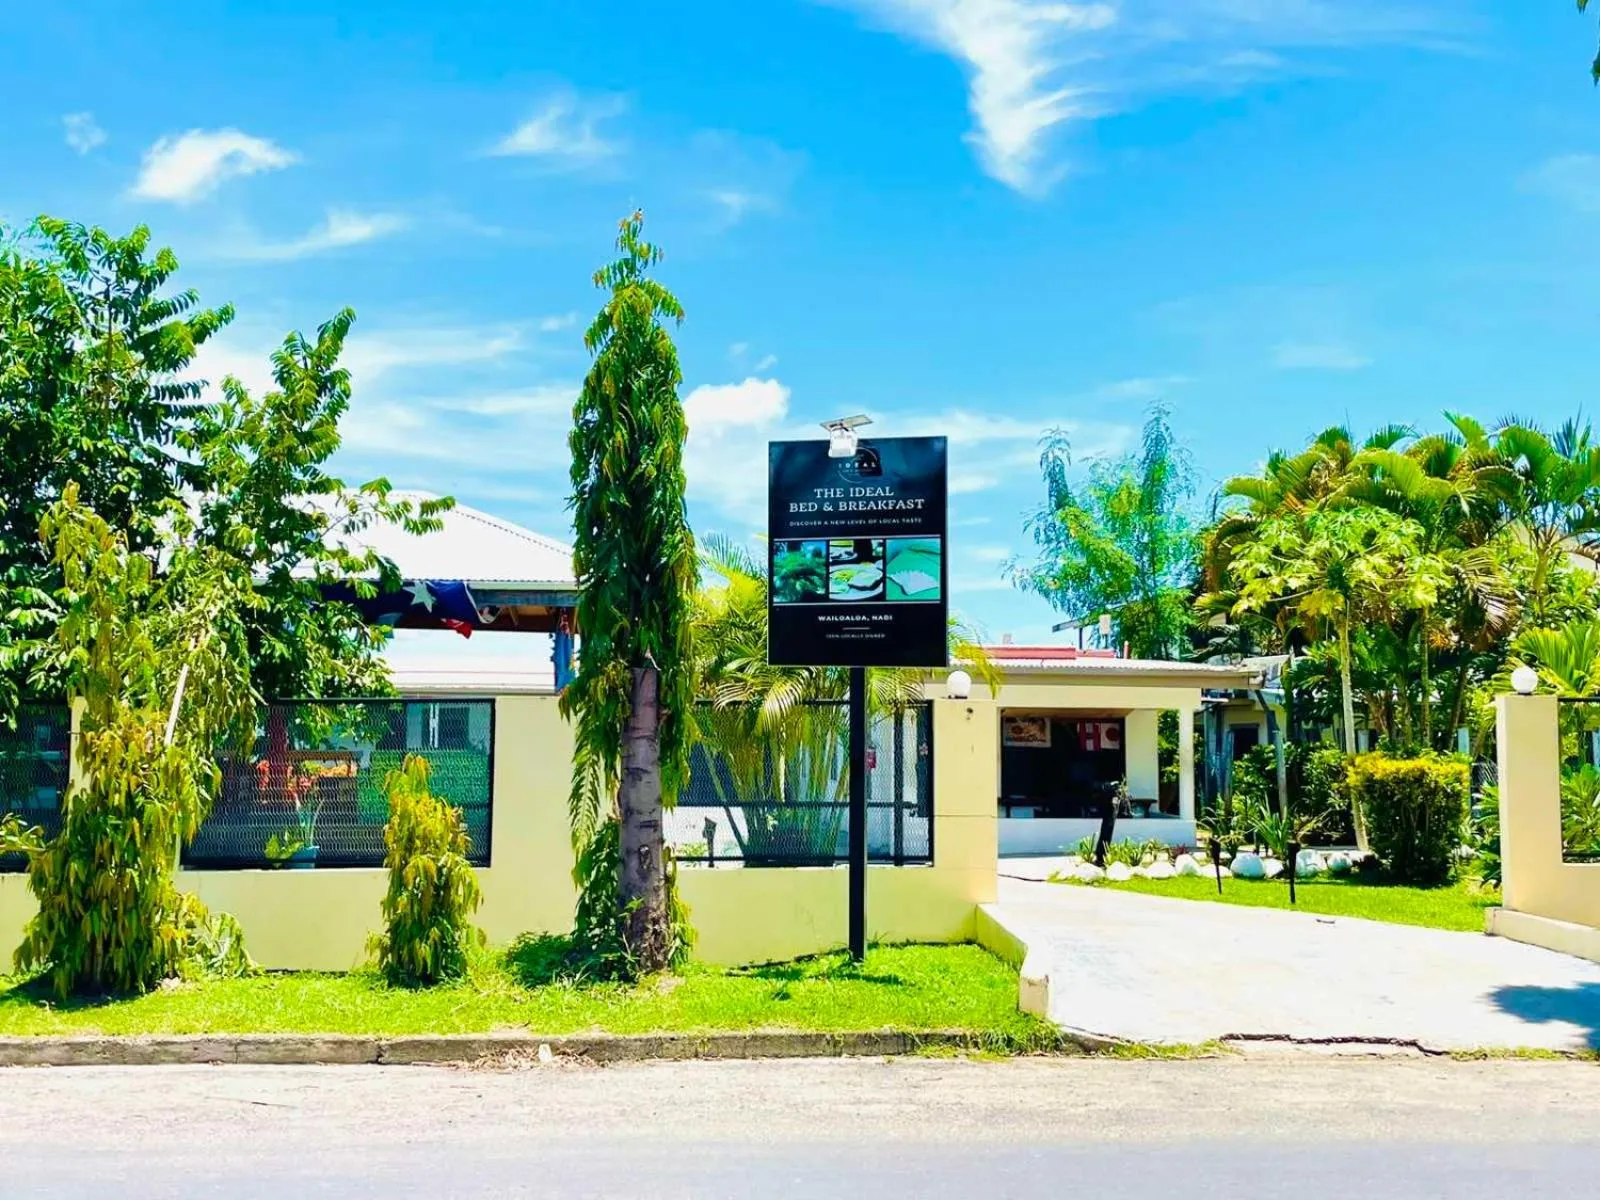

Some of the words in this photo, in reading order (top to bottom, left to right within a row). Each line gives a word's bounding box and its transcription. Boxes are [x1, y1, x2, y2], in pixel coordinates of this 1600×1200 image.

[814, 487, 845, 498] THE
[849, 486, 895, 497] IDEAL
[789, 501, 818, 513] BED
[822, 501, 834, 512] &
[838, 498, 925, 511] BREAKFAST
